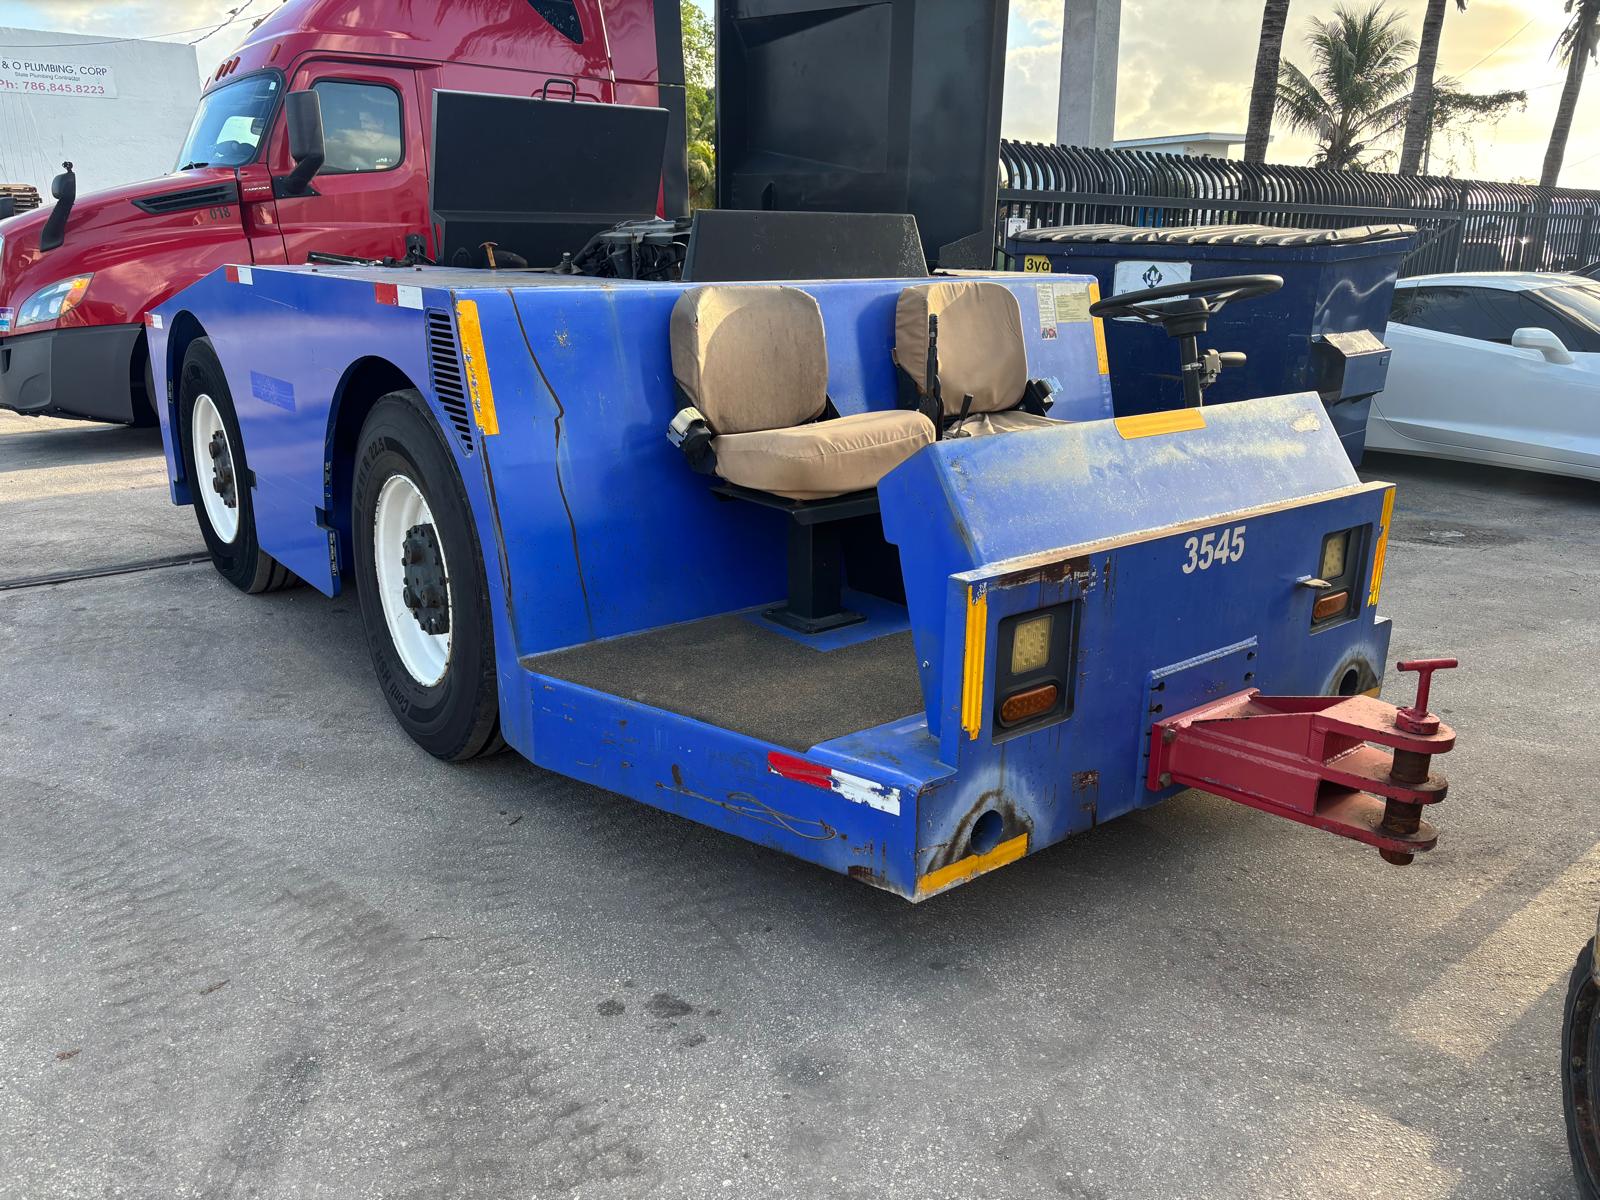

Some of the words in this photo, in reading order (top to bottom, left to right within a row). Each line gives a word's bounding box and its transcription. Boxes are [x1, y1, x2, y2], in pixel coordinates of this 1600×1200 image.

[12, 61, 21, 70] O
[80, 66, 107, 76] CORP
[210, 206, 230, 220] 018
[1182, 525, 1246, 574] 3545
